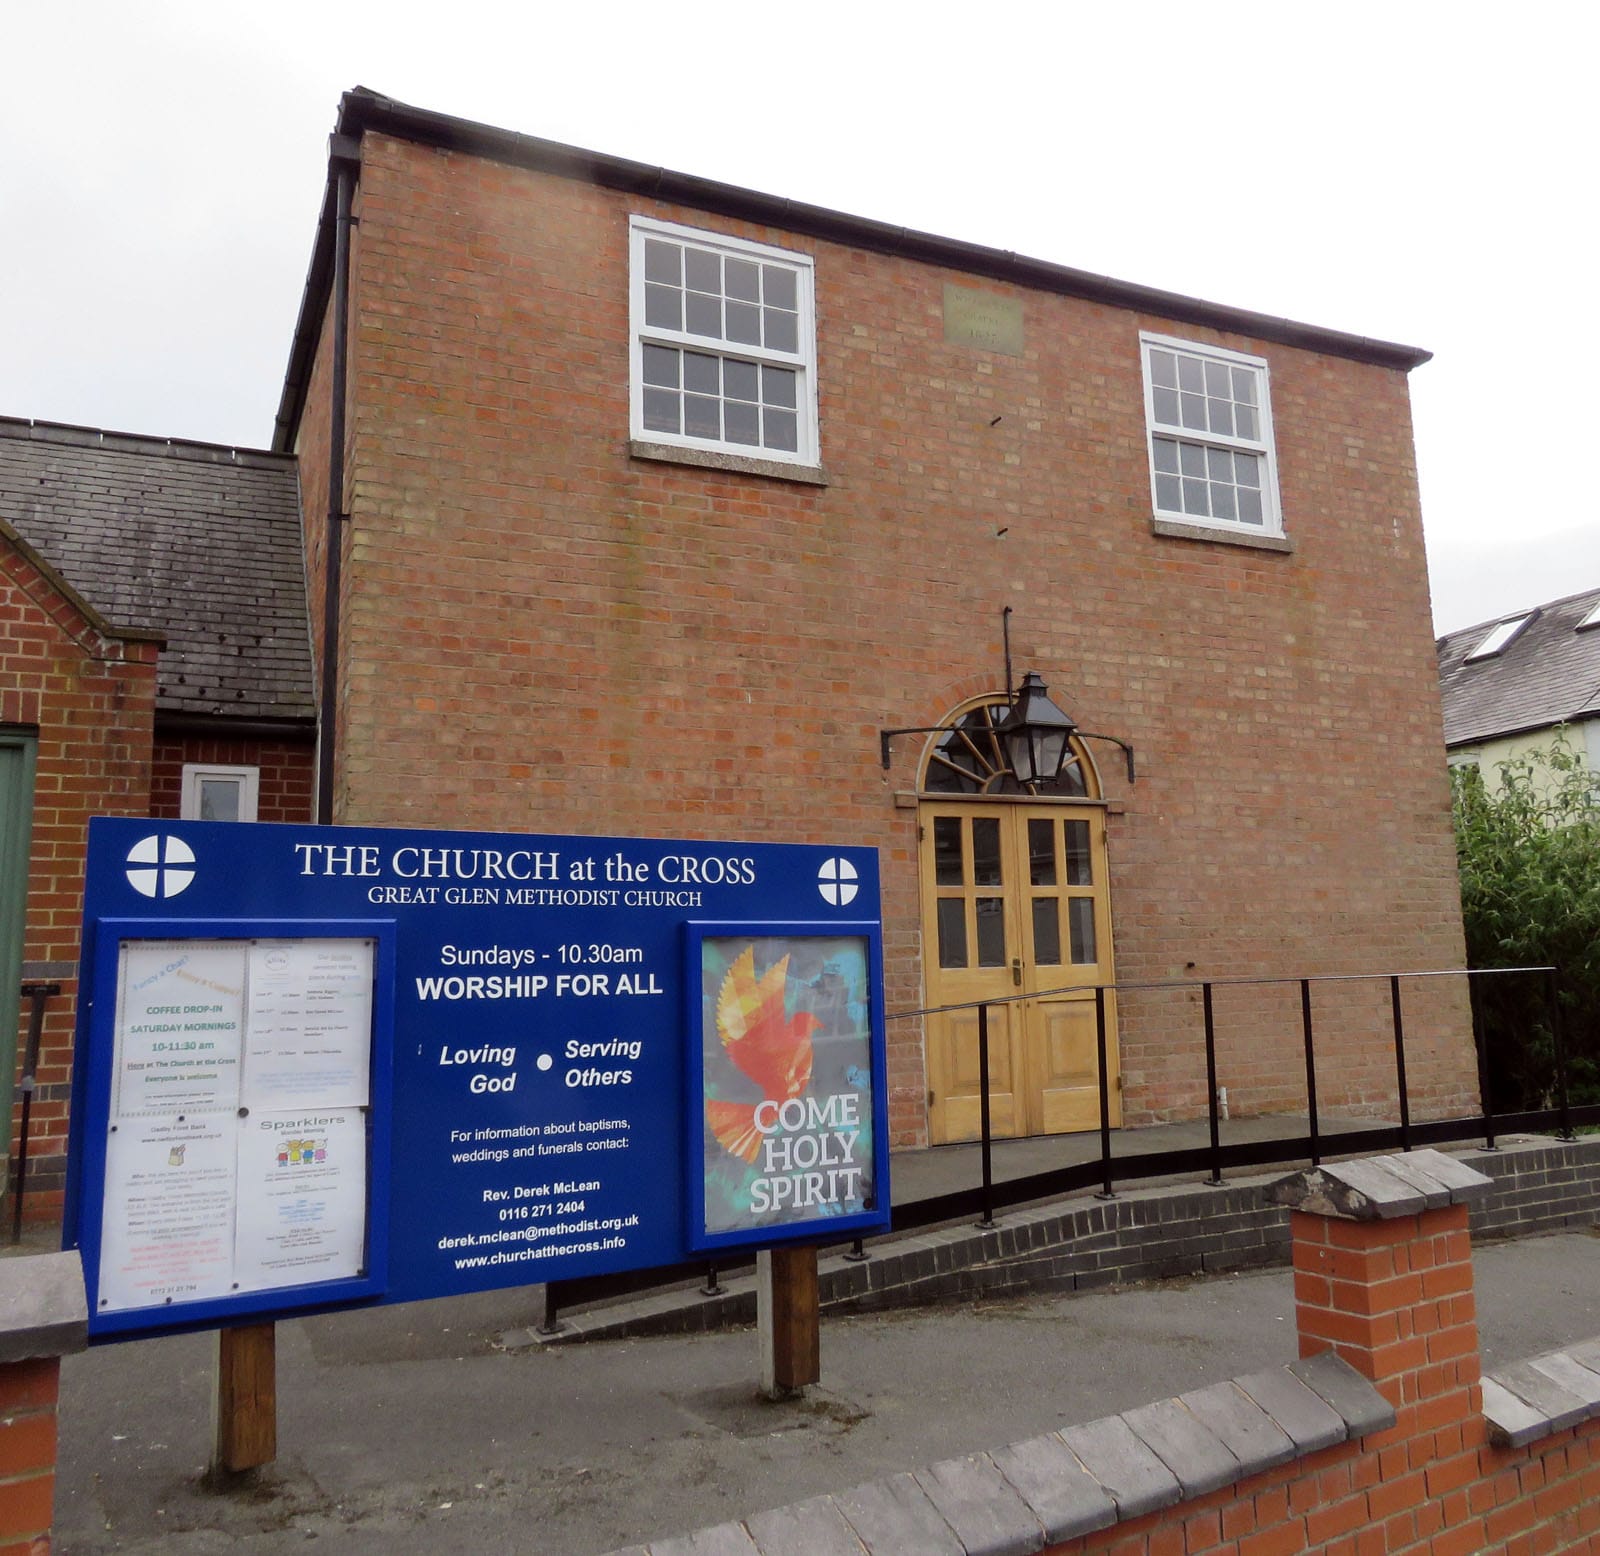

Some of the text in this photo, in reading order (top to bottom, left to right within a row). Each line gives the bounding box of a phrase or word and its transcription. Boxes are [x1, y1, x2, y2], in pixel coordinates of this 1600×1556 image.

[294, 843, 756, 885] THE CHURCH at the CROSS
[368, 886, 702, 907] GREAT GLEN METHODIST CHURCH
[440, 945, 535, 969] Sundays
[558, 944, 643, 964] 10.30am
[415, 973, 664, 1001] WORSHIP FOR ALL
[146, 1004, 223, 1015] COFFEE DROP-IN
[130, 1021, 237, 1034] SATURDAY MORNINGS
[151, 1041, 215, 1053] 10-11:30 am
[440, 1045, 516, 1067] Loving
[564, 1038, 642, 1060] Serving
[146, 1061, 154, 1069] at
[156, 1060, 169, 1068] The
[170, 1059, 195, 1068] Church
[469, 1072, 517, 1094] God
[565, 1067, 633, 1088] Others
[260, 1116, 346, 1131] Sparklers
[753, 1093, 860, 1134] COME
[451, 1119, 631, 1143] For information about baptisms,
[452, 1137, 630, 1163] weddings and funerals contact:
[763, 1130, 860, 1173] HOLY
[483, 1180, 600, 1202] Rev. Derek McLean
[750, 1167, 862, 1213] SPIRIT
[499, 1199, 586, 1221] 0116 271 2404
[438, 1214, 639, 1250] derek.mclean@methodist.org.uk
[454, 1236, 626, 1270] www.churchatthecross.info
